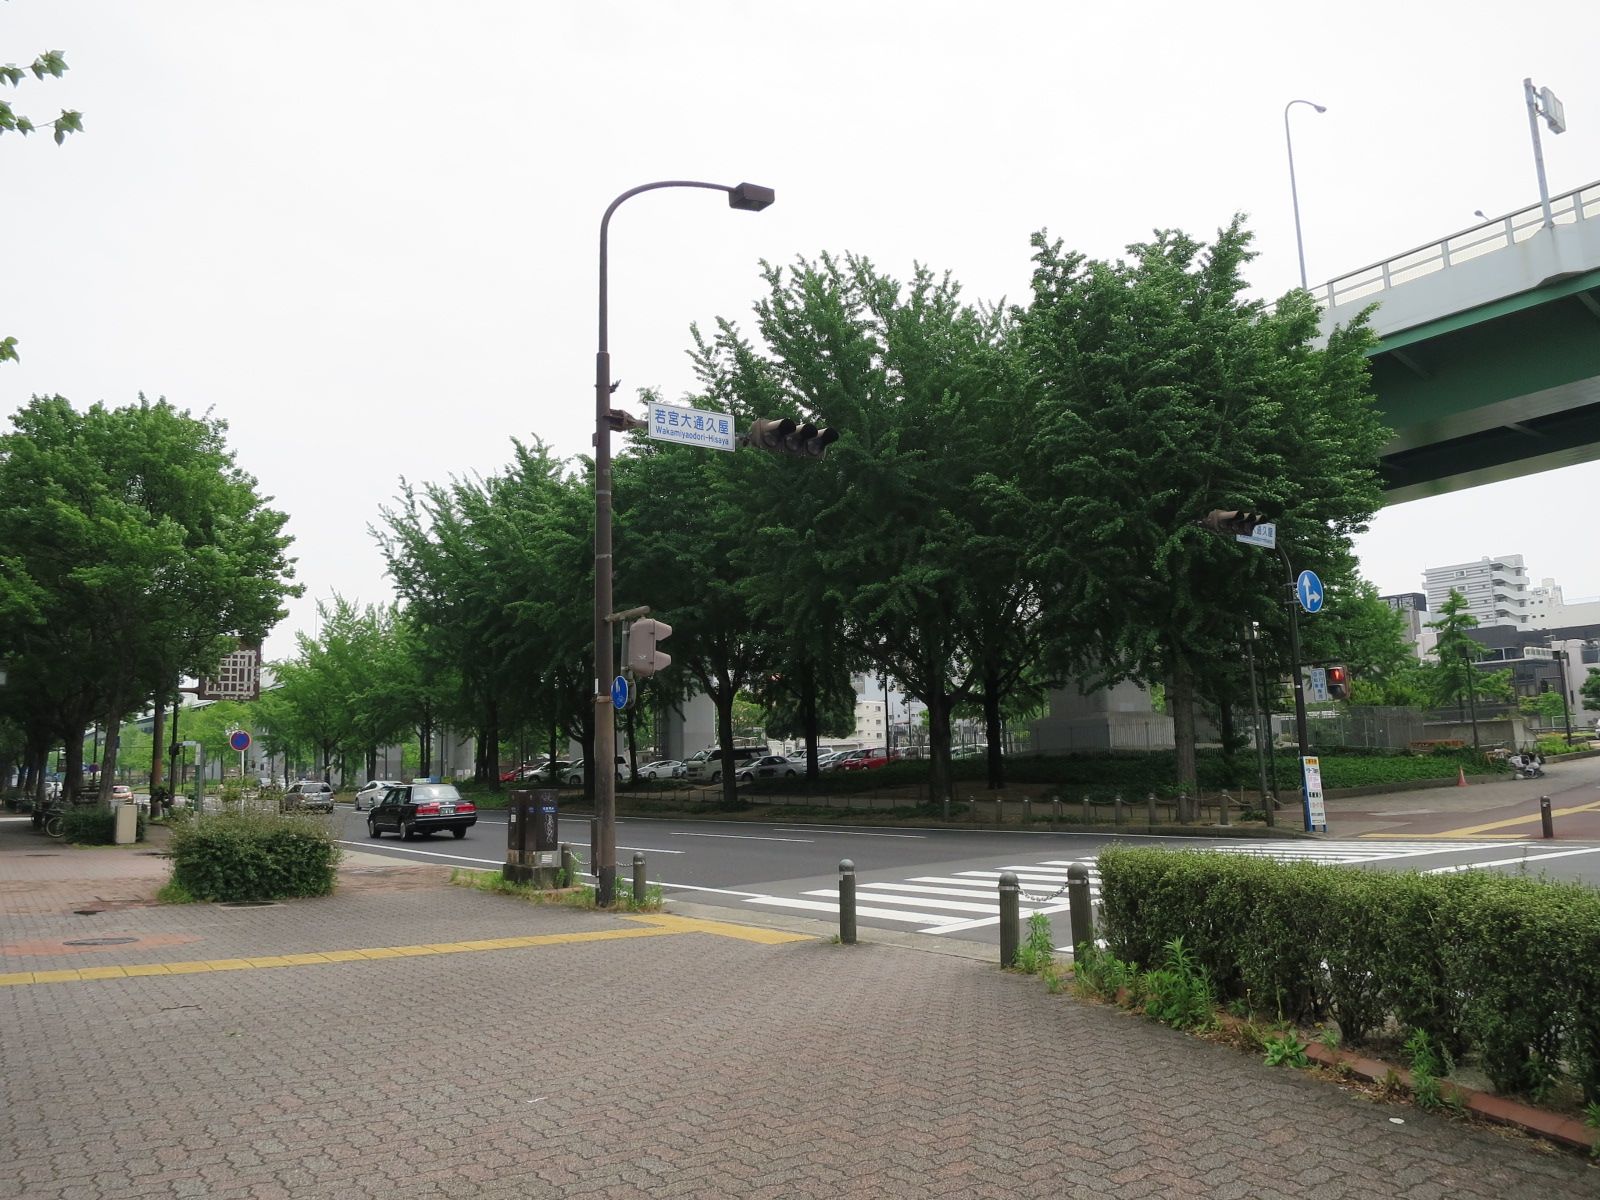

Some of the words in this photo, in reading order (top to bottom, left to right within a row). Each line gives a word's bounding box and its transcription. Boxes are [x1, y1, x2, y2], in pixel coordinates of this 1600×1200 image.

[655, 408, 729, 435] 若宮大通久屋
[656, 426, 729, 445] Wakamiyaodori-Hisaya
